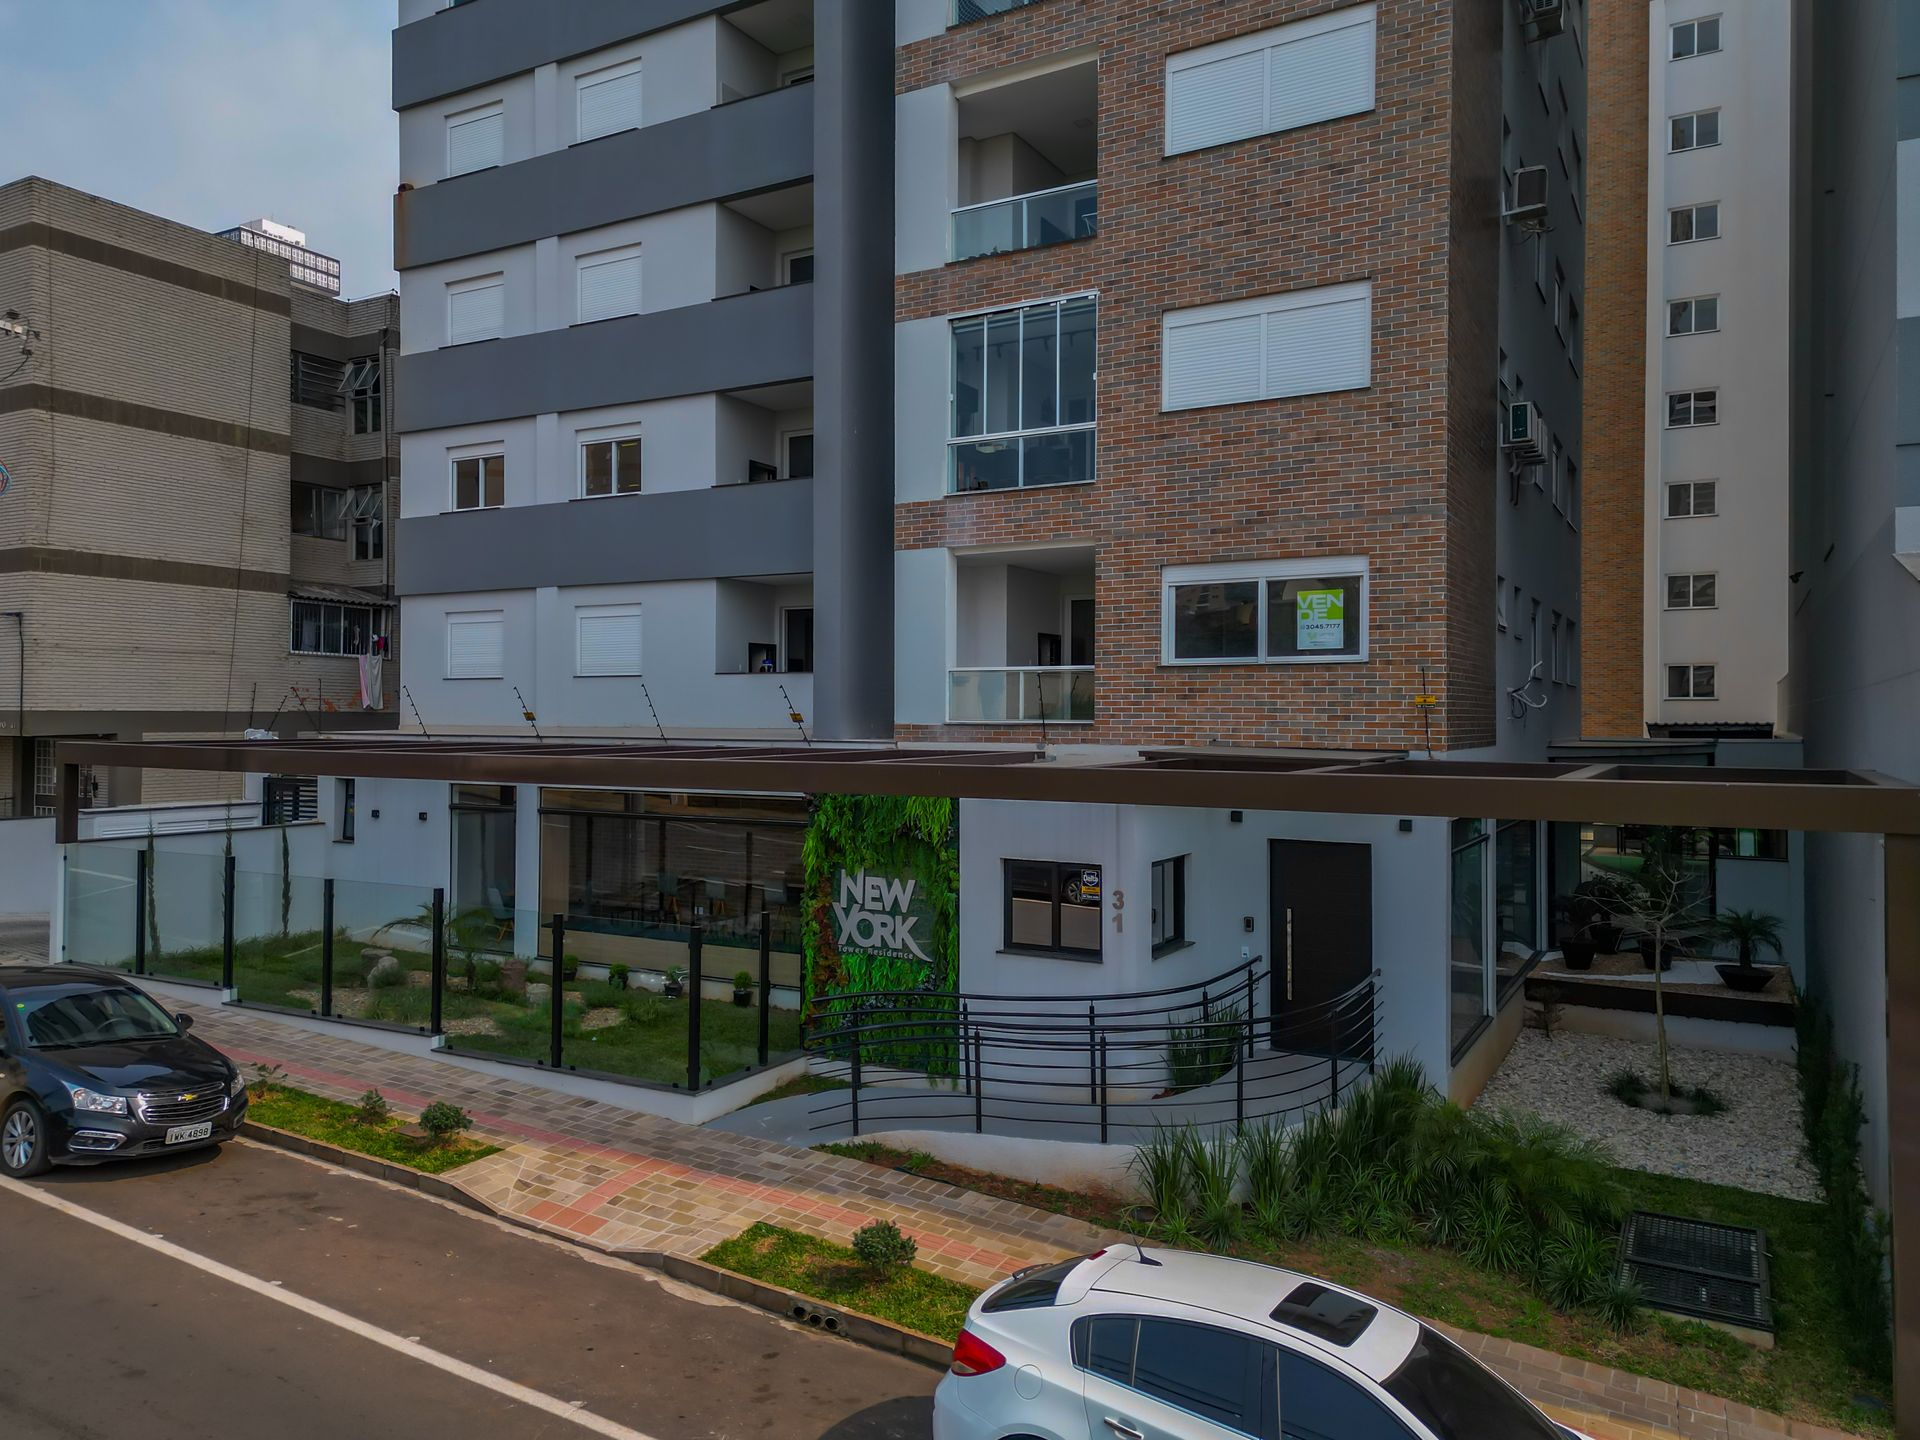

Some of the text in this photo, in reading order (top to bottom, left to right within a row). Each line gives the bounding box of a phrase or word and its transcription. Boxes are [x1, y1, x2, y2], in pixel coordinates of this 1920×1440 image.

[1297, 593, 1343, 609] VEN
[1297, 608, 1329, 622] DE
[840, 867, 916, 913] NEW
[832, 901, 933, 962] YORK
[838, 945, 913, 959] Tower Residence
[188, 1128, 209, 1138] 4898
